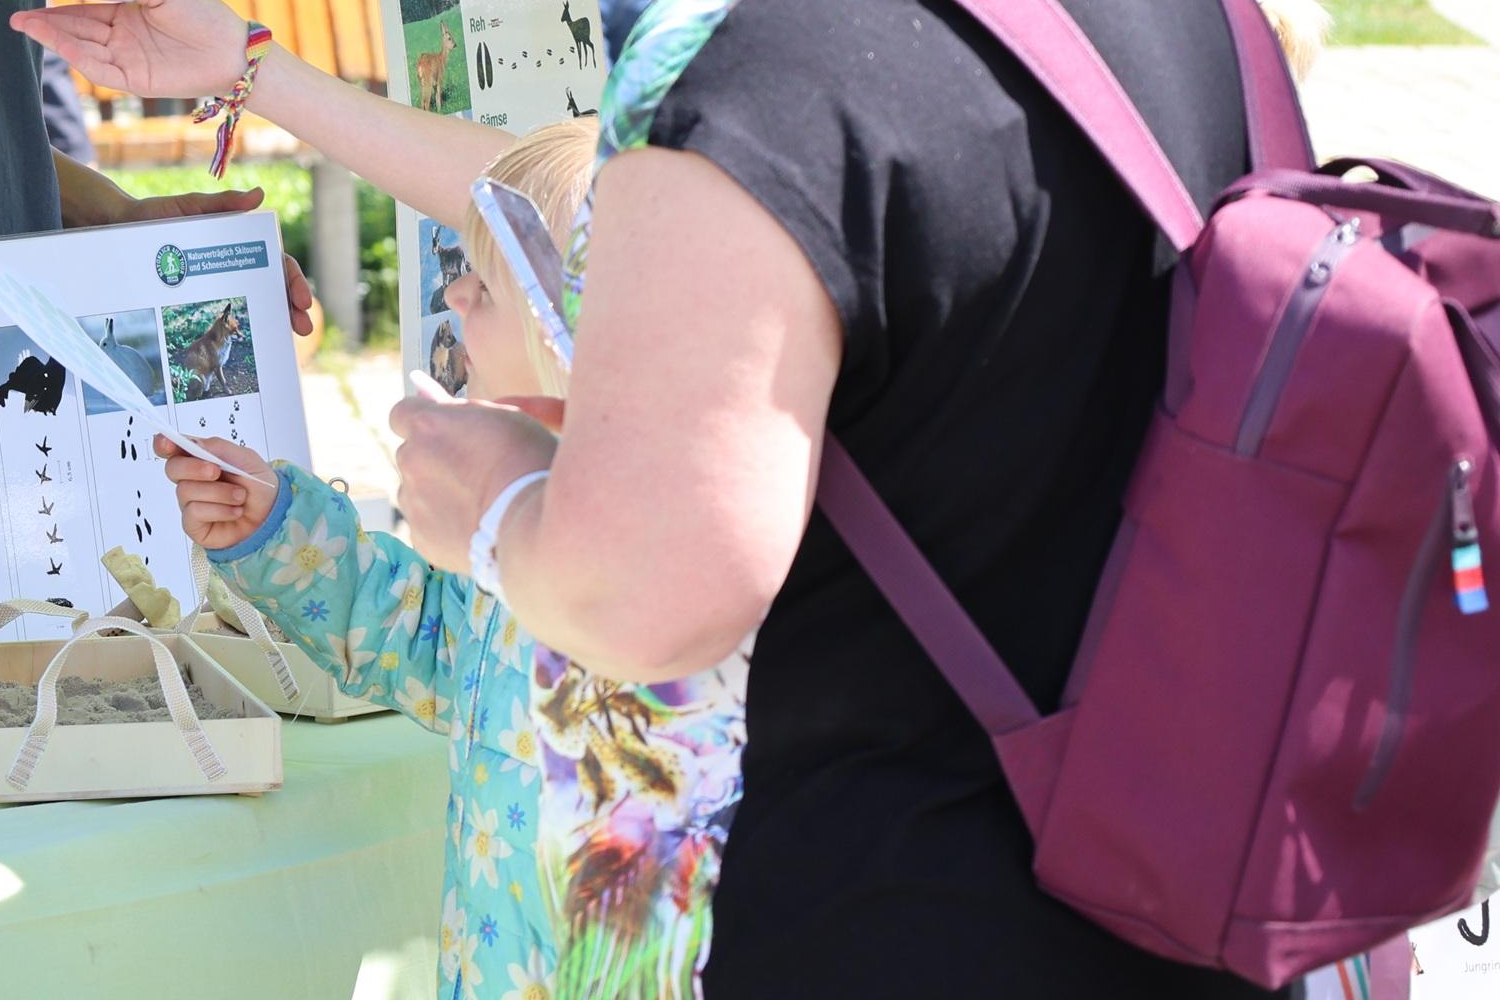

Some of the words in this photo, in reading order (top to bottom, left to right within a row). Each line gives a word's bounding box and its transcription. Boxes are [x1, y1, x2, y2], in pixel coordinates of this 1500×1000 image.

[469, 15, 486, 33] Reh
[187, 247, 234, 260] Naturverträglich
[234, 245, 265, 256] Skitouren-
[189, 262, 201, 272] und
[201, 257, 257, 271] Schneeschuhgehen
